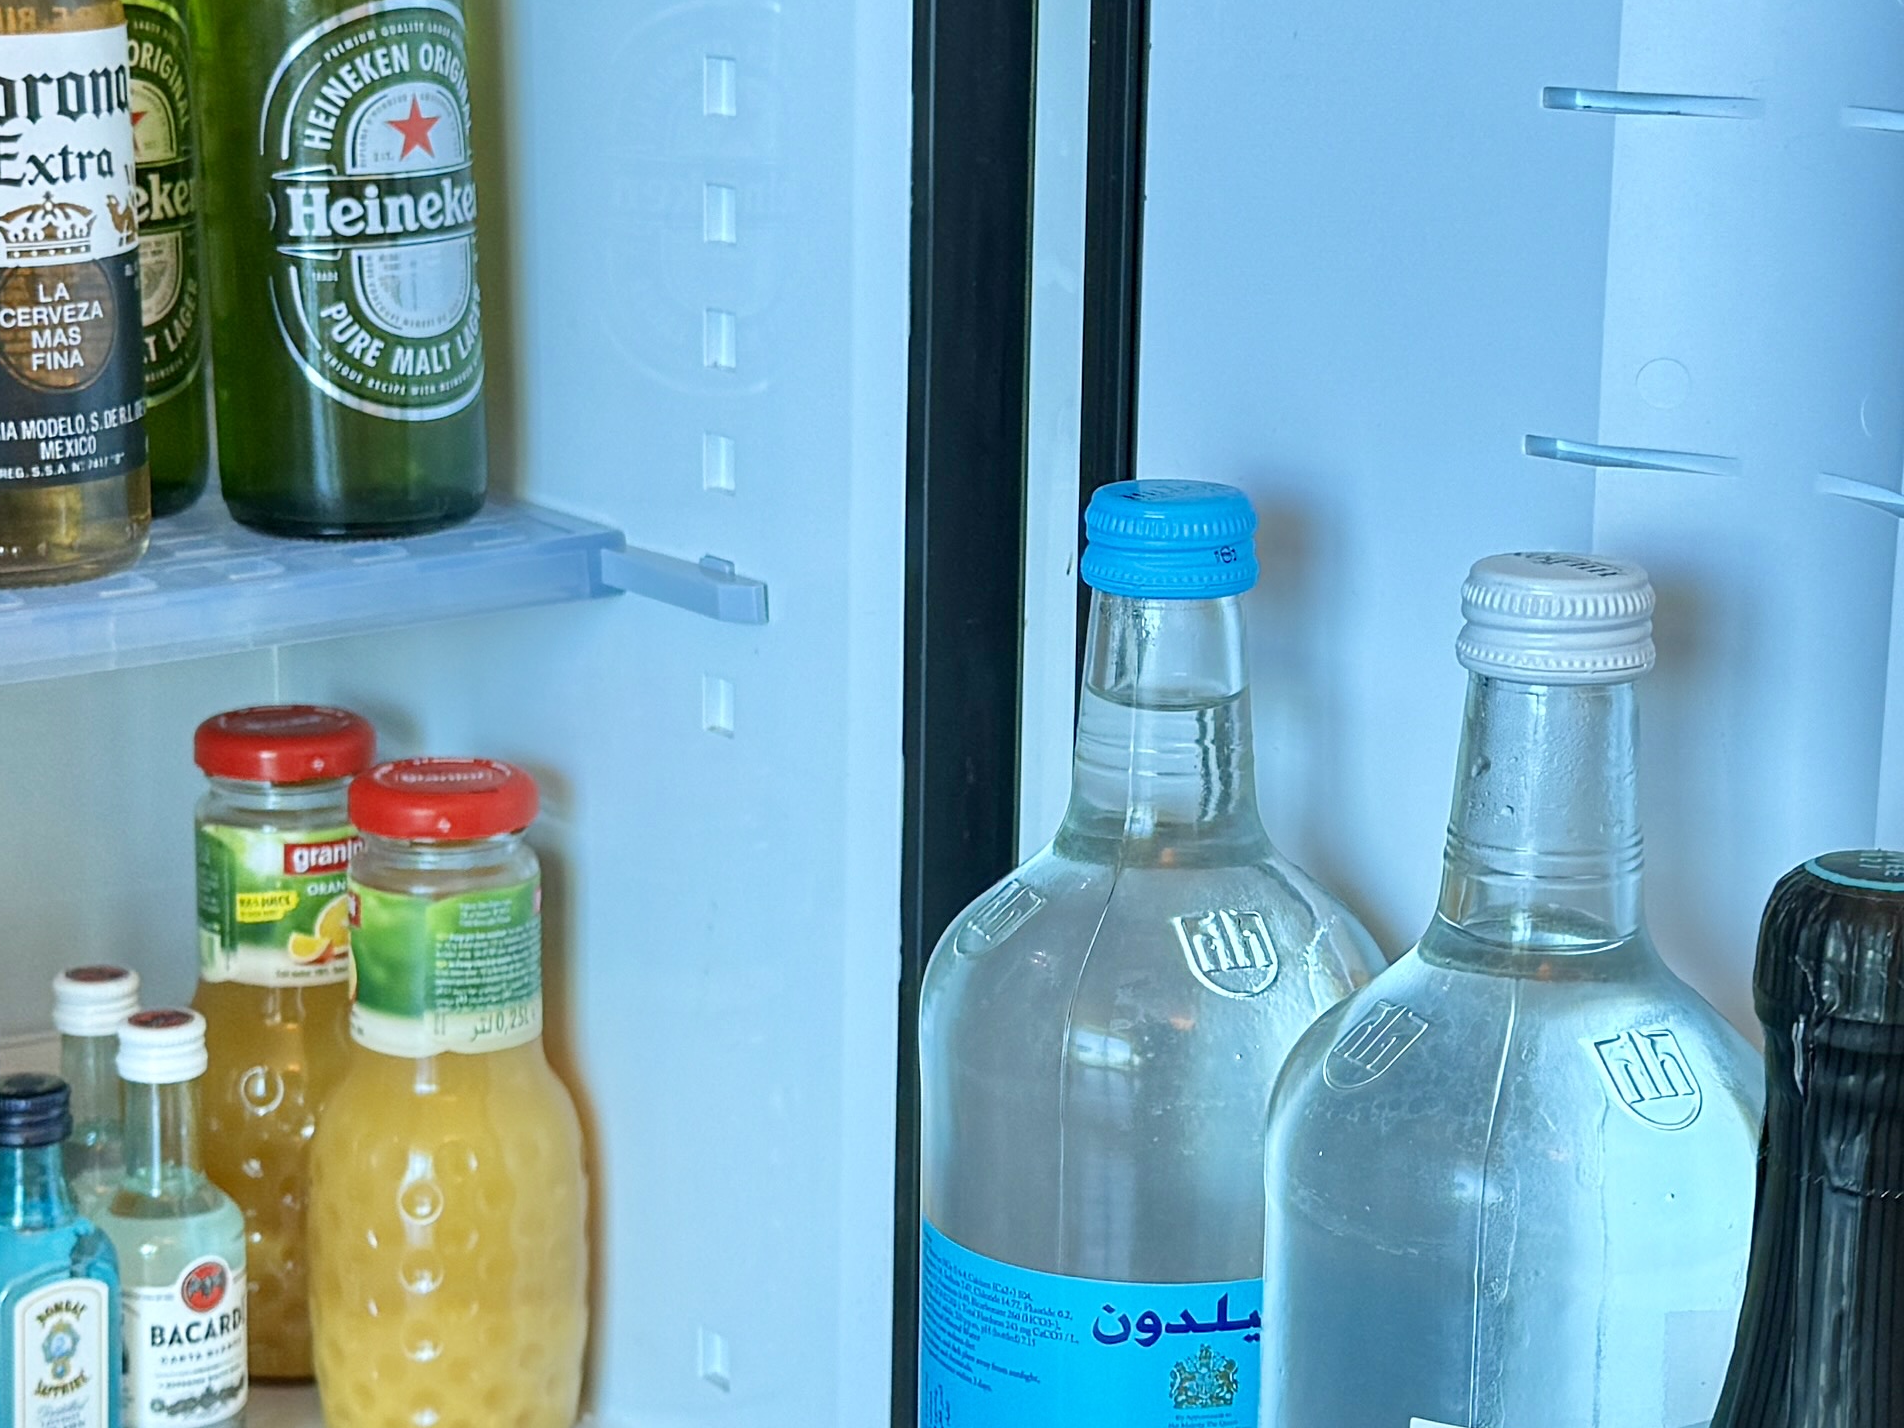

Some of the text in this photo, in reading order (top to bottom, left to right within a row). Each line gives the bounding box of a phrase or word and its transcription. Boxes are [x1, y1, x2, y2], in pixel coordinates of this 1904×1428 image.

[323, 28, 377, 62] PREMIUM
[303, 42, 411, 151] HEINEKEN
[38, 283, 70, 303] LA
[31, 326, 82, 349] MAS
[320, 300, 452, 376] PURE MALT
[31, 349, 84, 371] FINA
[39, 435, 97, 461] MEXICO
